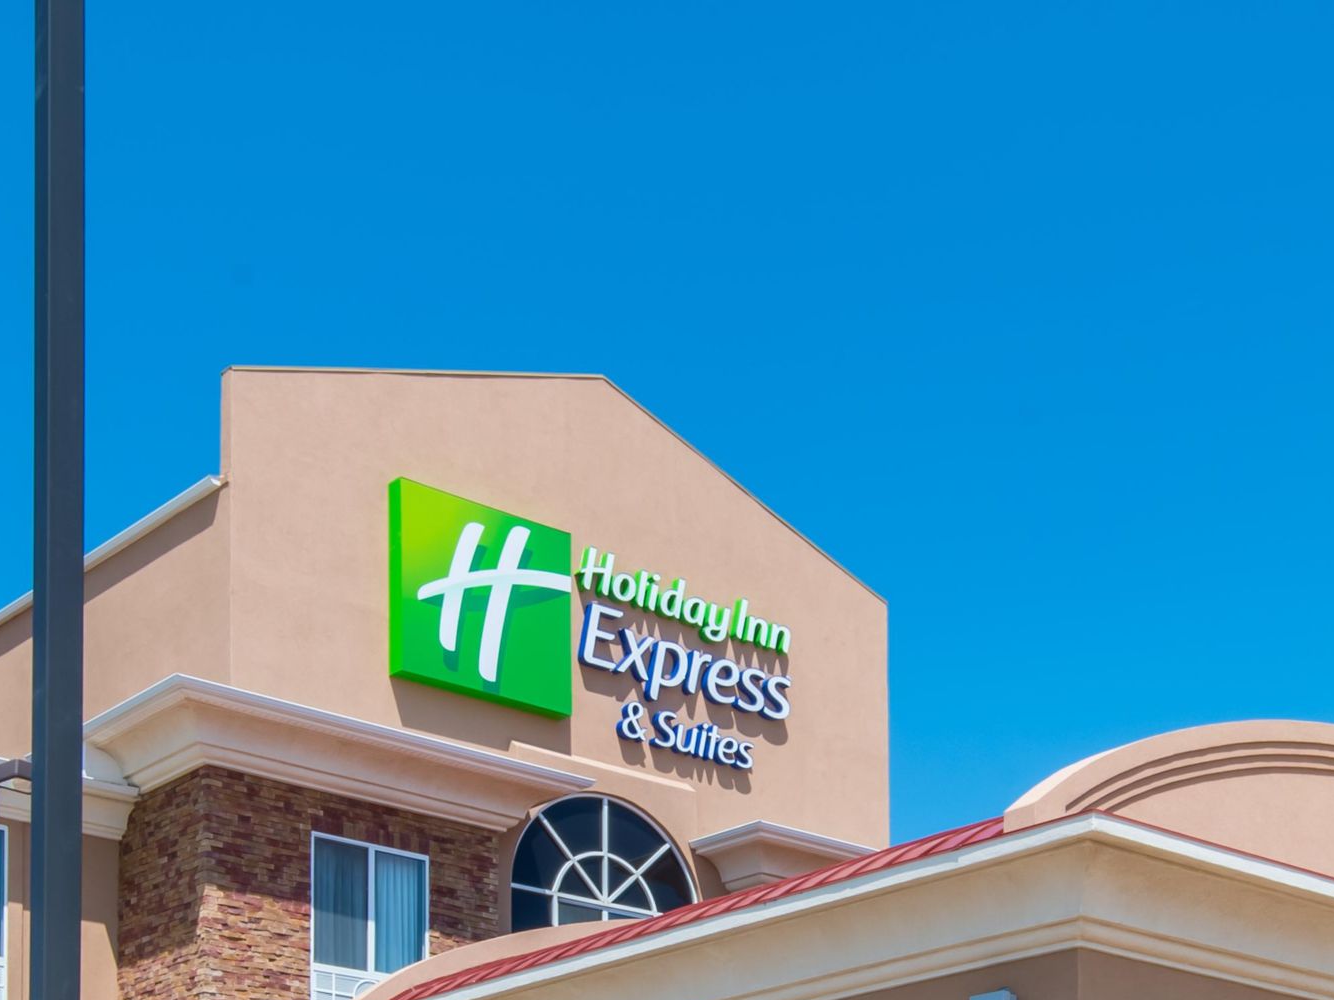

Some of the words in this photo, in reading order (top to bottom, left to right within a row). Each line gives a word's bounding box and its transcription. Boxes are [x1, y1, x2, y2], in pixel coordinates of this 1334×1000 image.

[576, 546, 731, 642] Holiday
[732, 598, 791, 654] Inn
[579, 602, 791, 720] Express
[617, 701, 647, 742] &
[651, 711, 754, 770] Suites
